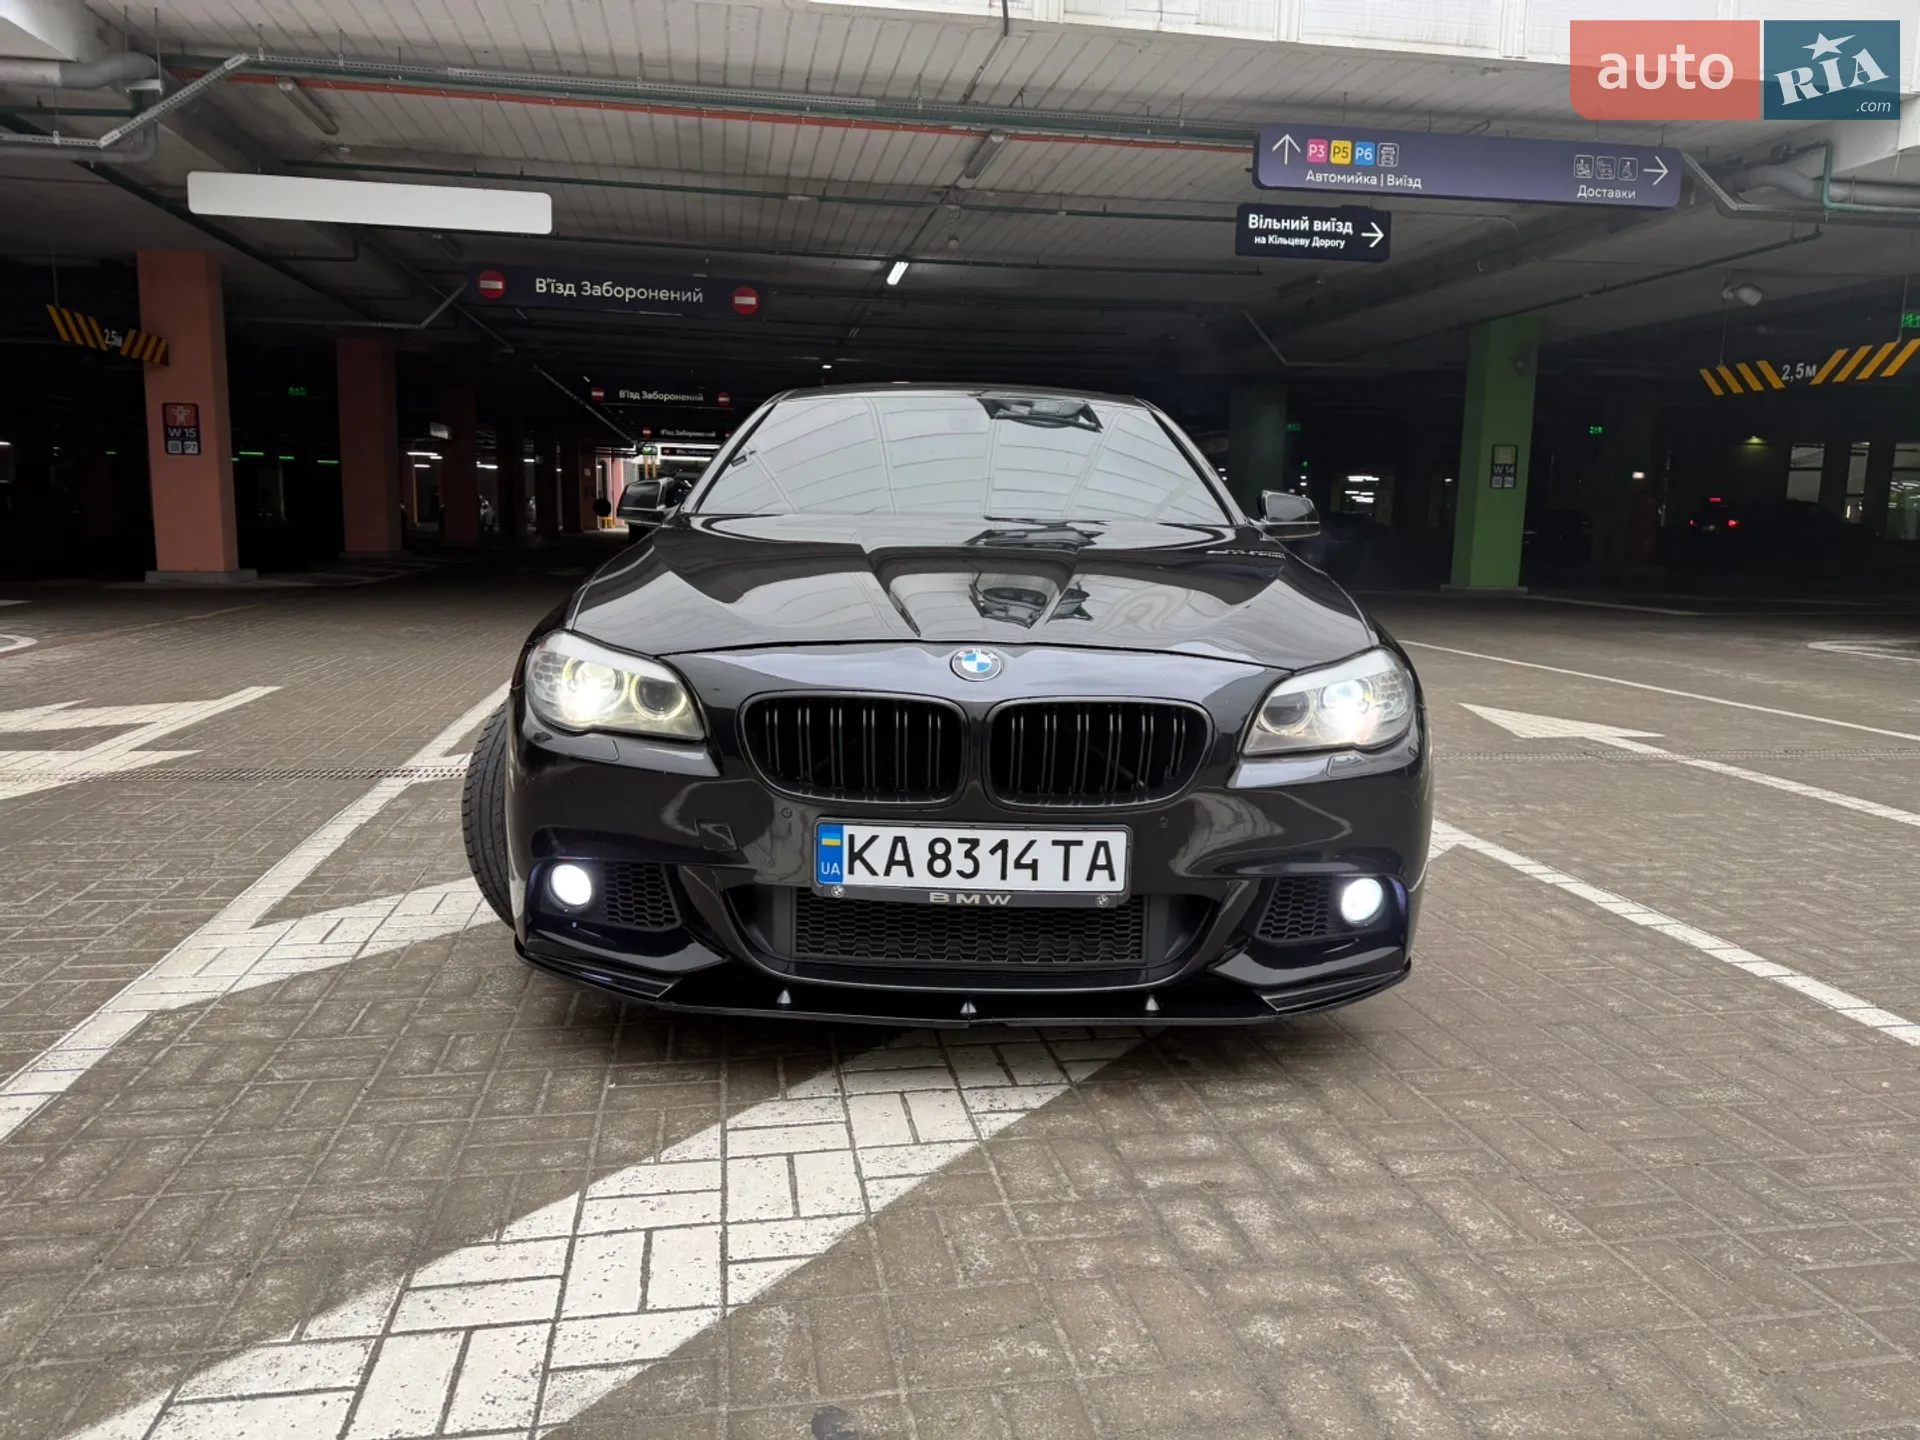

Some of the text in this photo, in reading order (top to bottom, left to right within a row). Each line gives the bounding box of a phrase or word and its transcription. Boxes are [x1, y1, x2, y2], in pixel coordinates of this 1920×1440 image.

[1308, 145, 1373, 161] P3 P5 P6
[1305, 169, 1422, 189] Автомийка Виїзд
[1577, 184, 1636, 199] Доставки
[1248, 213, 1354, 235] Вільний виїзд
[1254, 234, 1346, 250] на Кільцеву Дорогу
[580, 280, 704, 303] Заборонений
[167, 427, 197, 438] W 15
[847, 833, 1117, 882] KA 8314 TA
[820, 861, 841, 876] UA
[929, 891, 1011, 906] BMW
